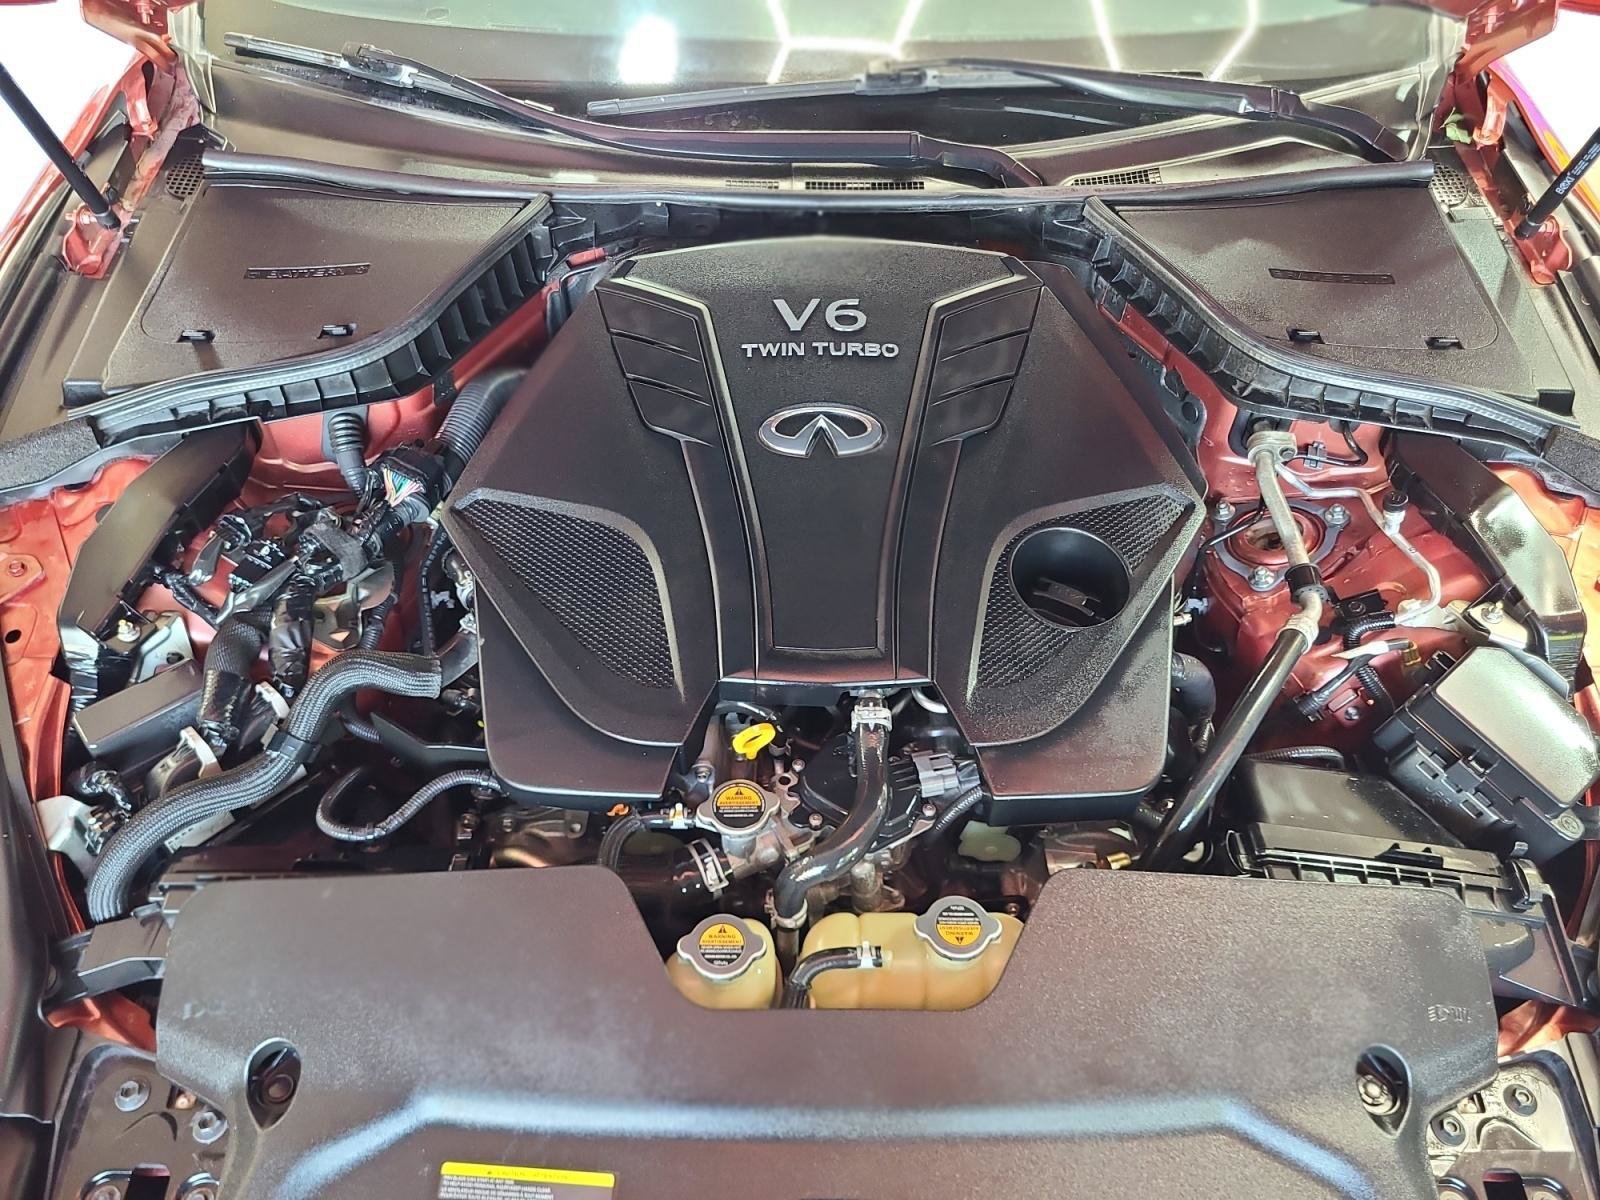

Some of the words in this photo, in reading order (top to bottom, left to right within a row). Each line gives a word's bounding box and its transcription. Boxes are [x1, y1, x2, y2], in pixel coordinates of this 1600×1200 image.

[773, 298, 868, 332] V6
[741, 341, 805, 358] TWIN
[811, 341, 899, 358] TURBO
